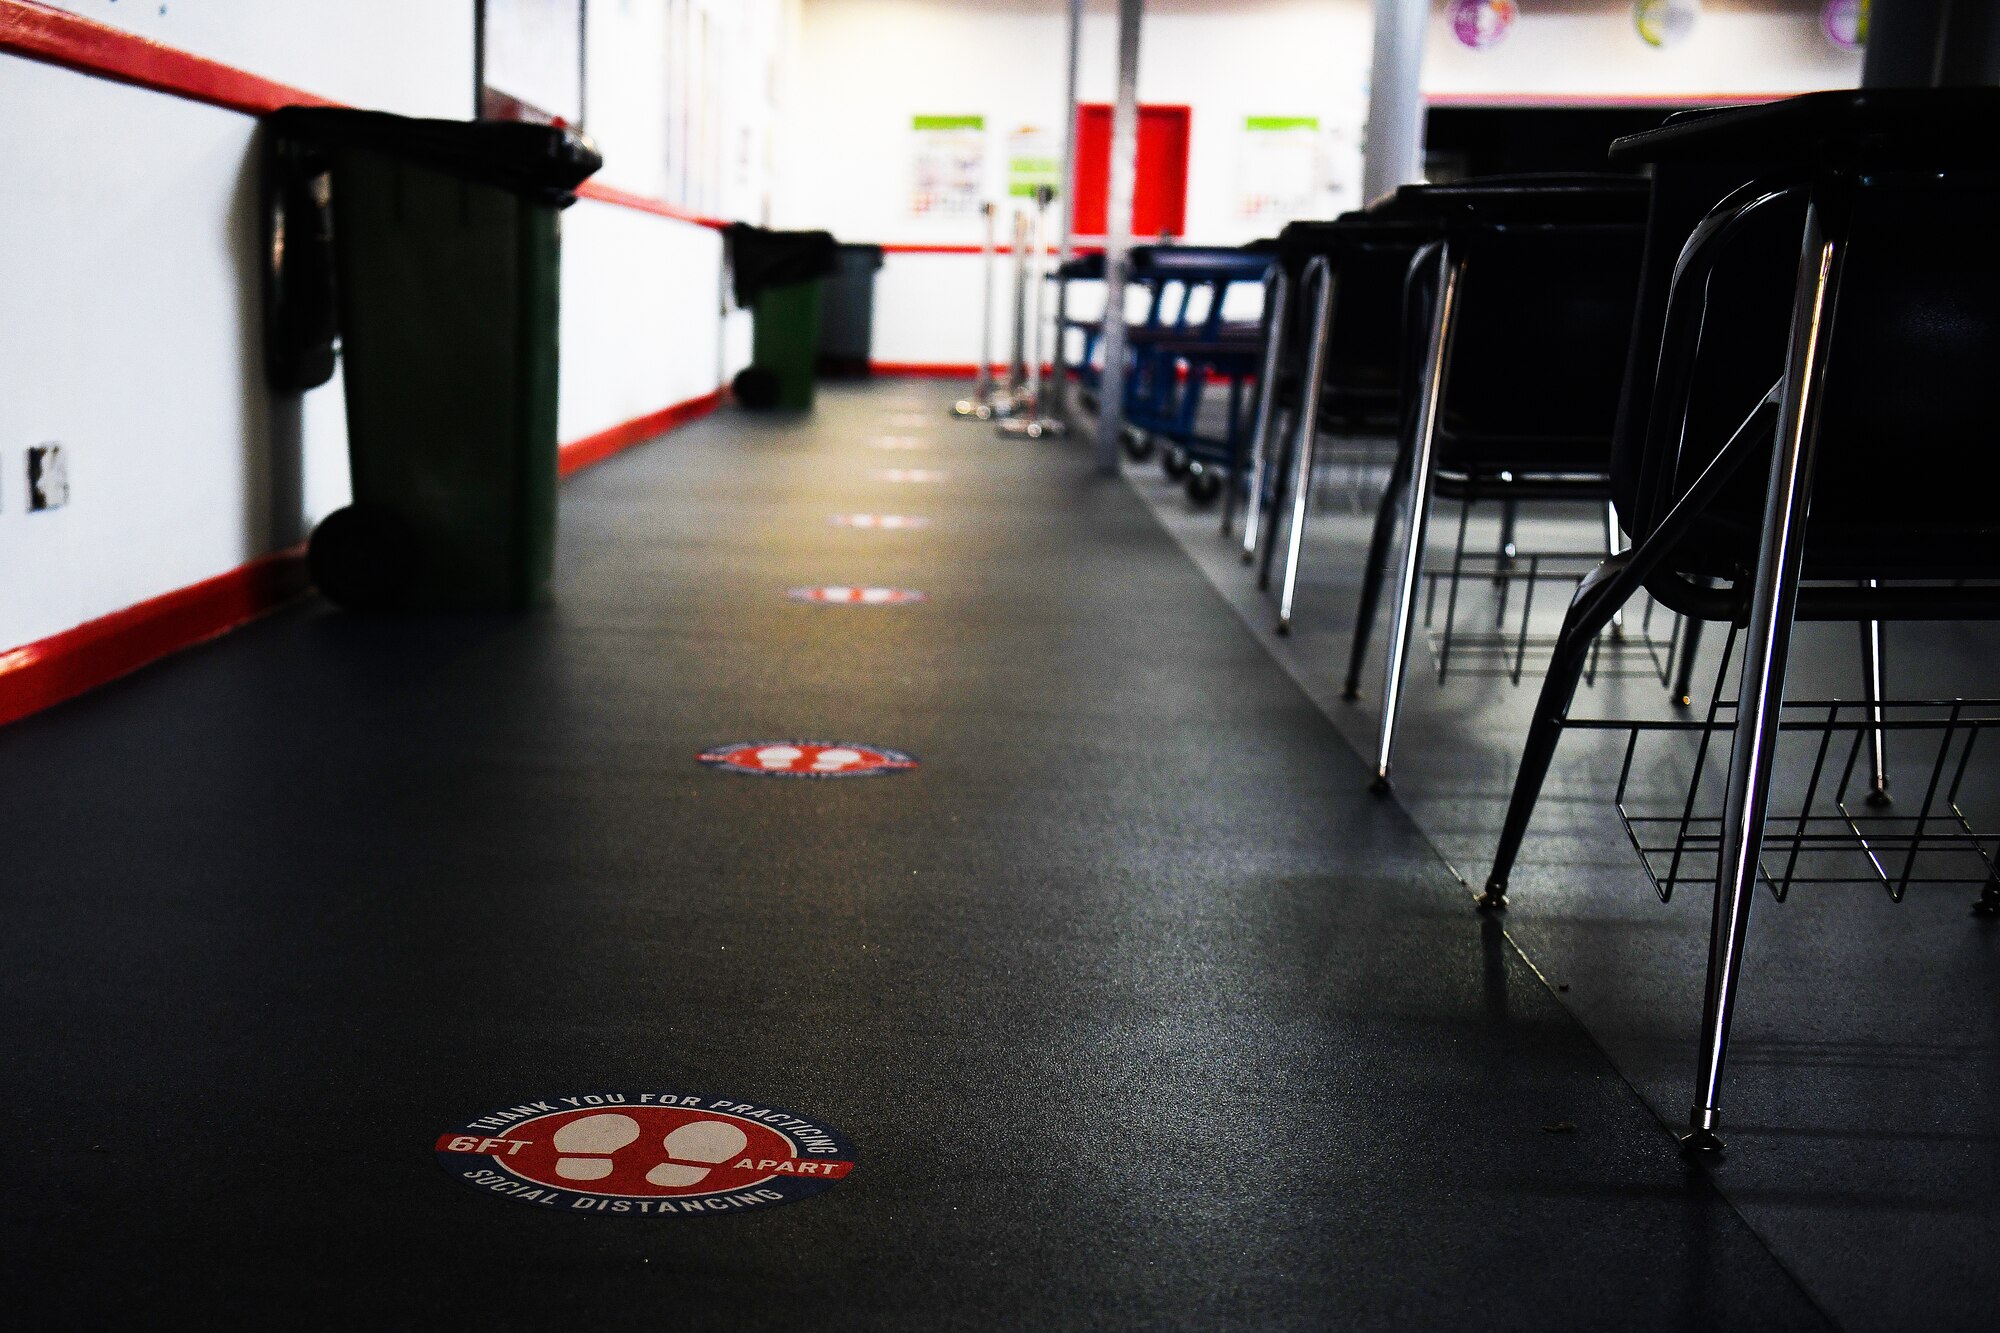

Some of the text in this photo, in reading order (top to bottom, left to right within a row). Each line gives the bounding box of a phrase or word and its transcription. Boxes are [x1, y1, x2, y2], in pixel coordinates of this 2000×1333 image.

[467, 1093, 839, 1154] THANK YOU FOR PRACTICING
[447, 1136, 839, 1175] 6FT APART
[463, 1169, 785, 1213] SOCIAL DISTANCING
